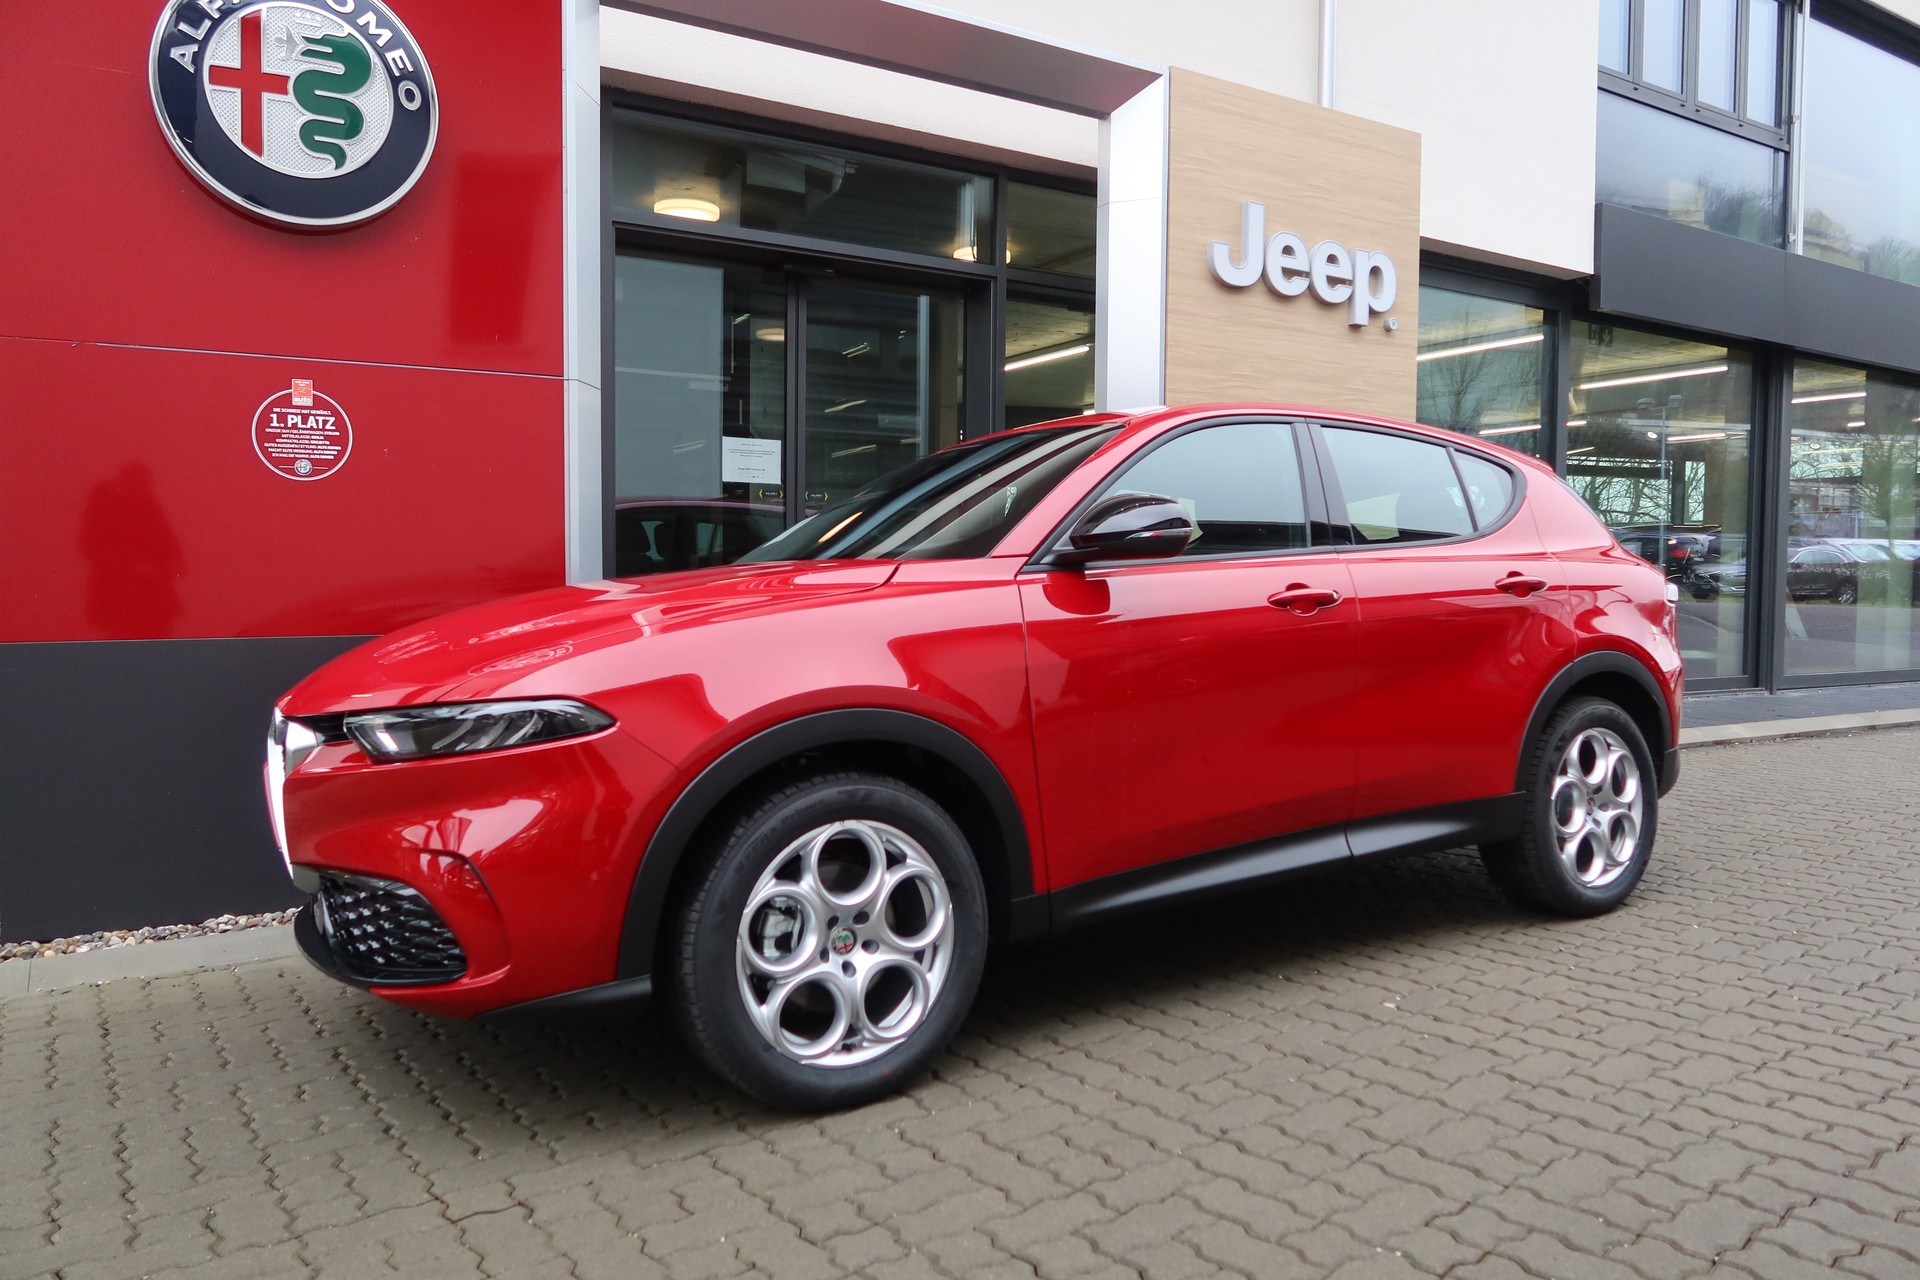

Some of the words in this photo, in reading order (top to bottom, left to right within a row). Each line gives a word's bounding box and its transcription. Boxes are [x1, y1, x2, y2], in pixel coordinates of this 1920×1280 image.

[170, 0, 240, 74] ALF
[325, 0, 422, 111] OMEO
[1207, 200, 1397, 327] Jeep
[269, 414, 284, 427] 1.
[287, 414, 336, 430] PLATZ
